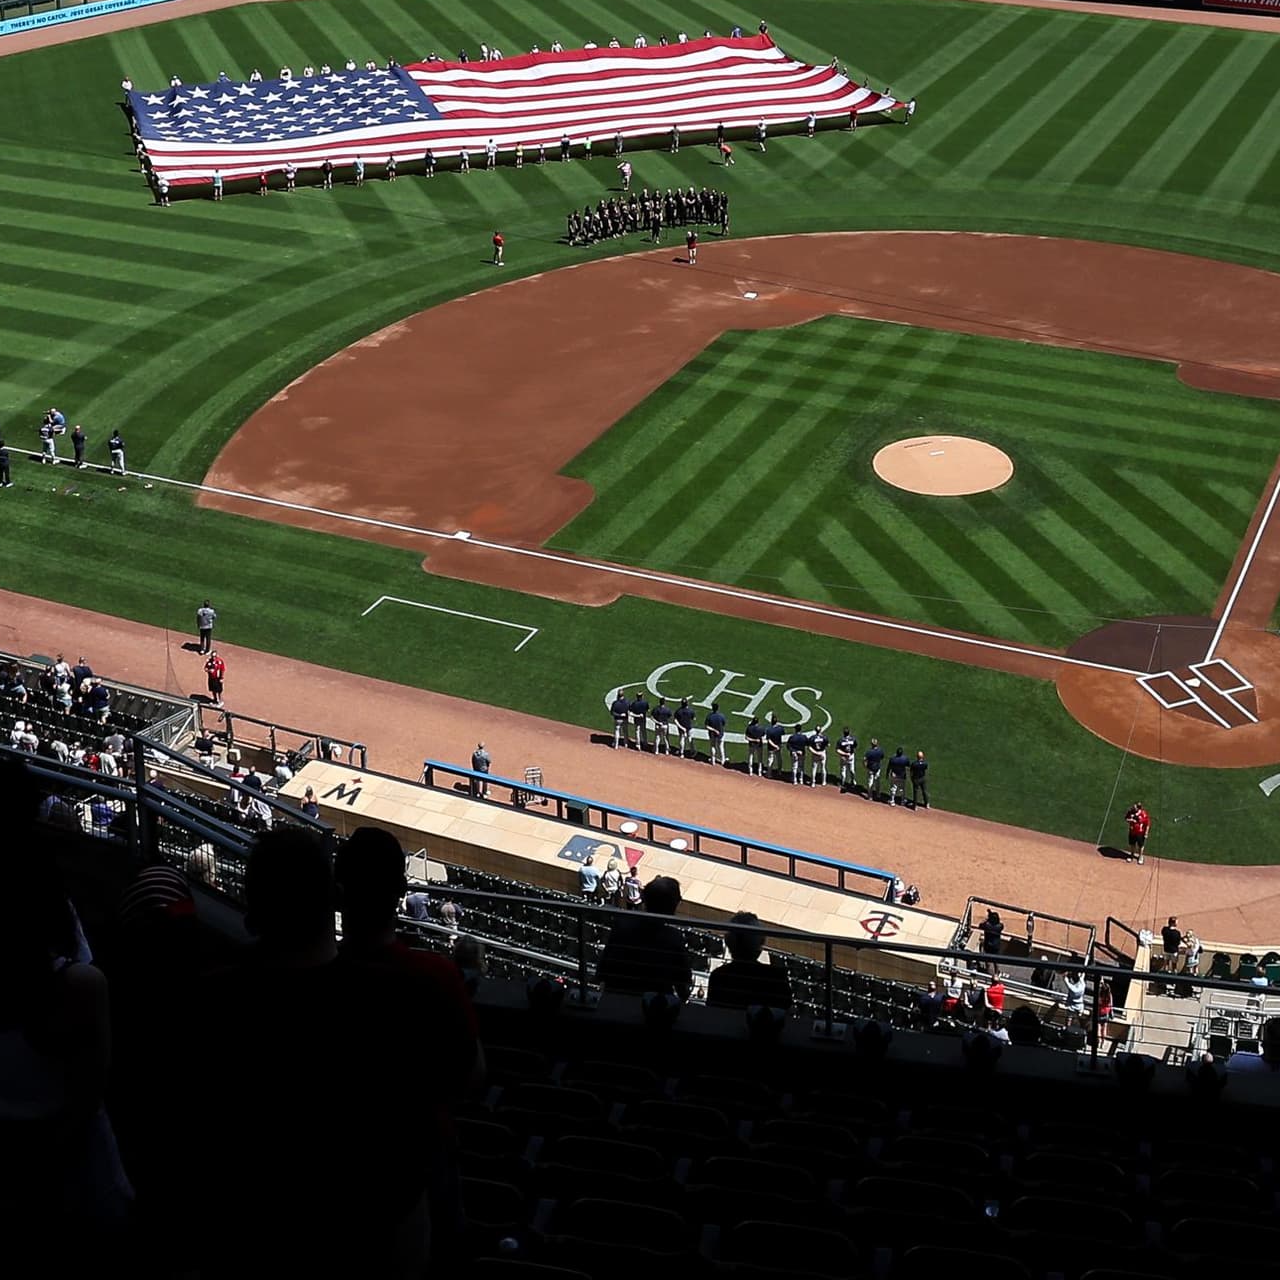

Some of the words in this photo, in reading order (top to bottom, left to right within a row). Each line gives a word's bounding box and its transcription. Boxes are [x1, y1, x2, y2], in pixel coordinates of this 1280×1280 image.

[10, 18, 36, 31] THERE'S
[36, 16, 47, 25] NO
[70, 8, 85, 19] JUST
[85, 4, 105, 15] GREAT
[645, 661, 823, 728] CHS
